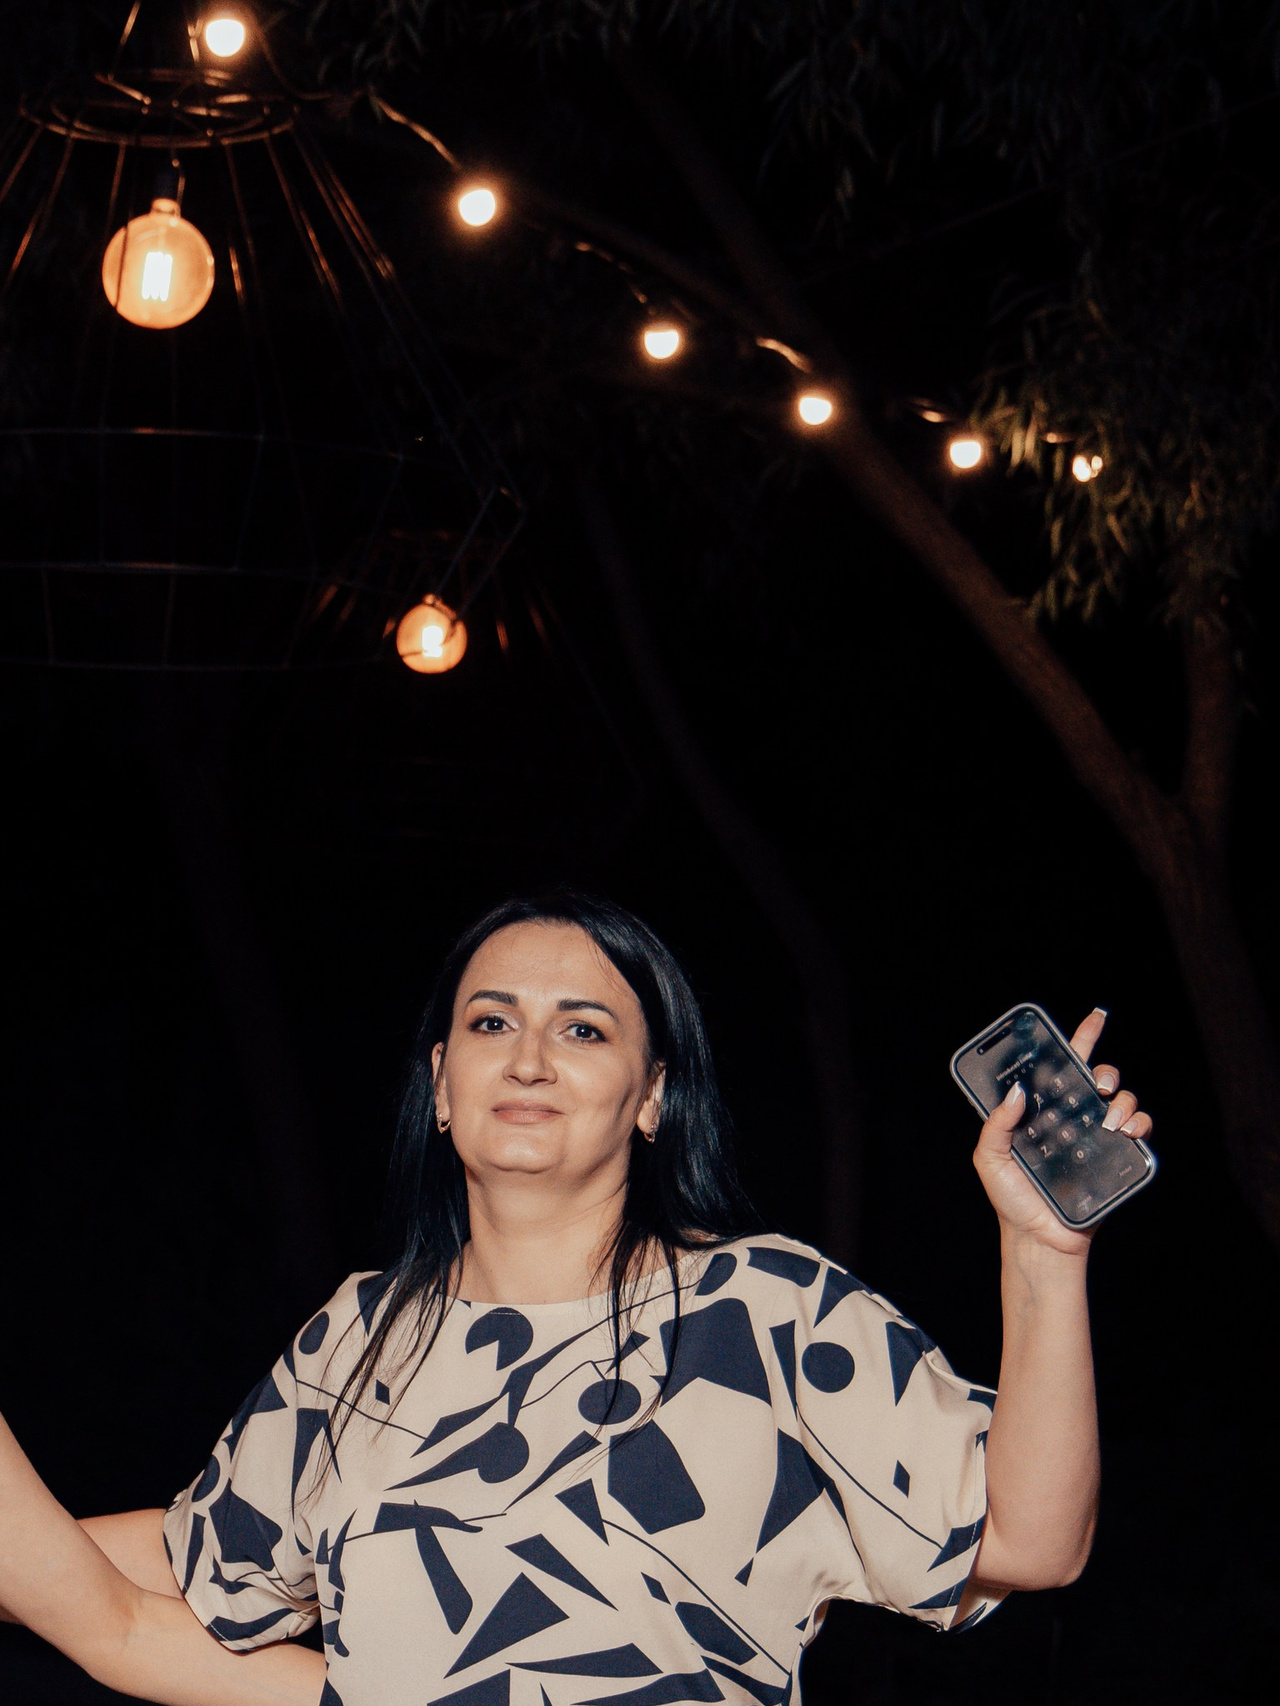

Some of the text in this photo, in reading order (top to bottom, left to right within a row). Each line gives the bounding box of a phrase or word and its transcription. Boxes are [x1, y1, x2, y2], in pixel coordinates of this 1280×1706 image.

[1028, 1126, 1035, 1135] 4
[1040, 1145, 1048, 1154] 7
[1076, 1150, 1084, 1159] 0
